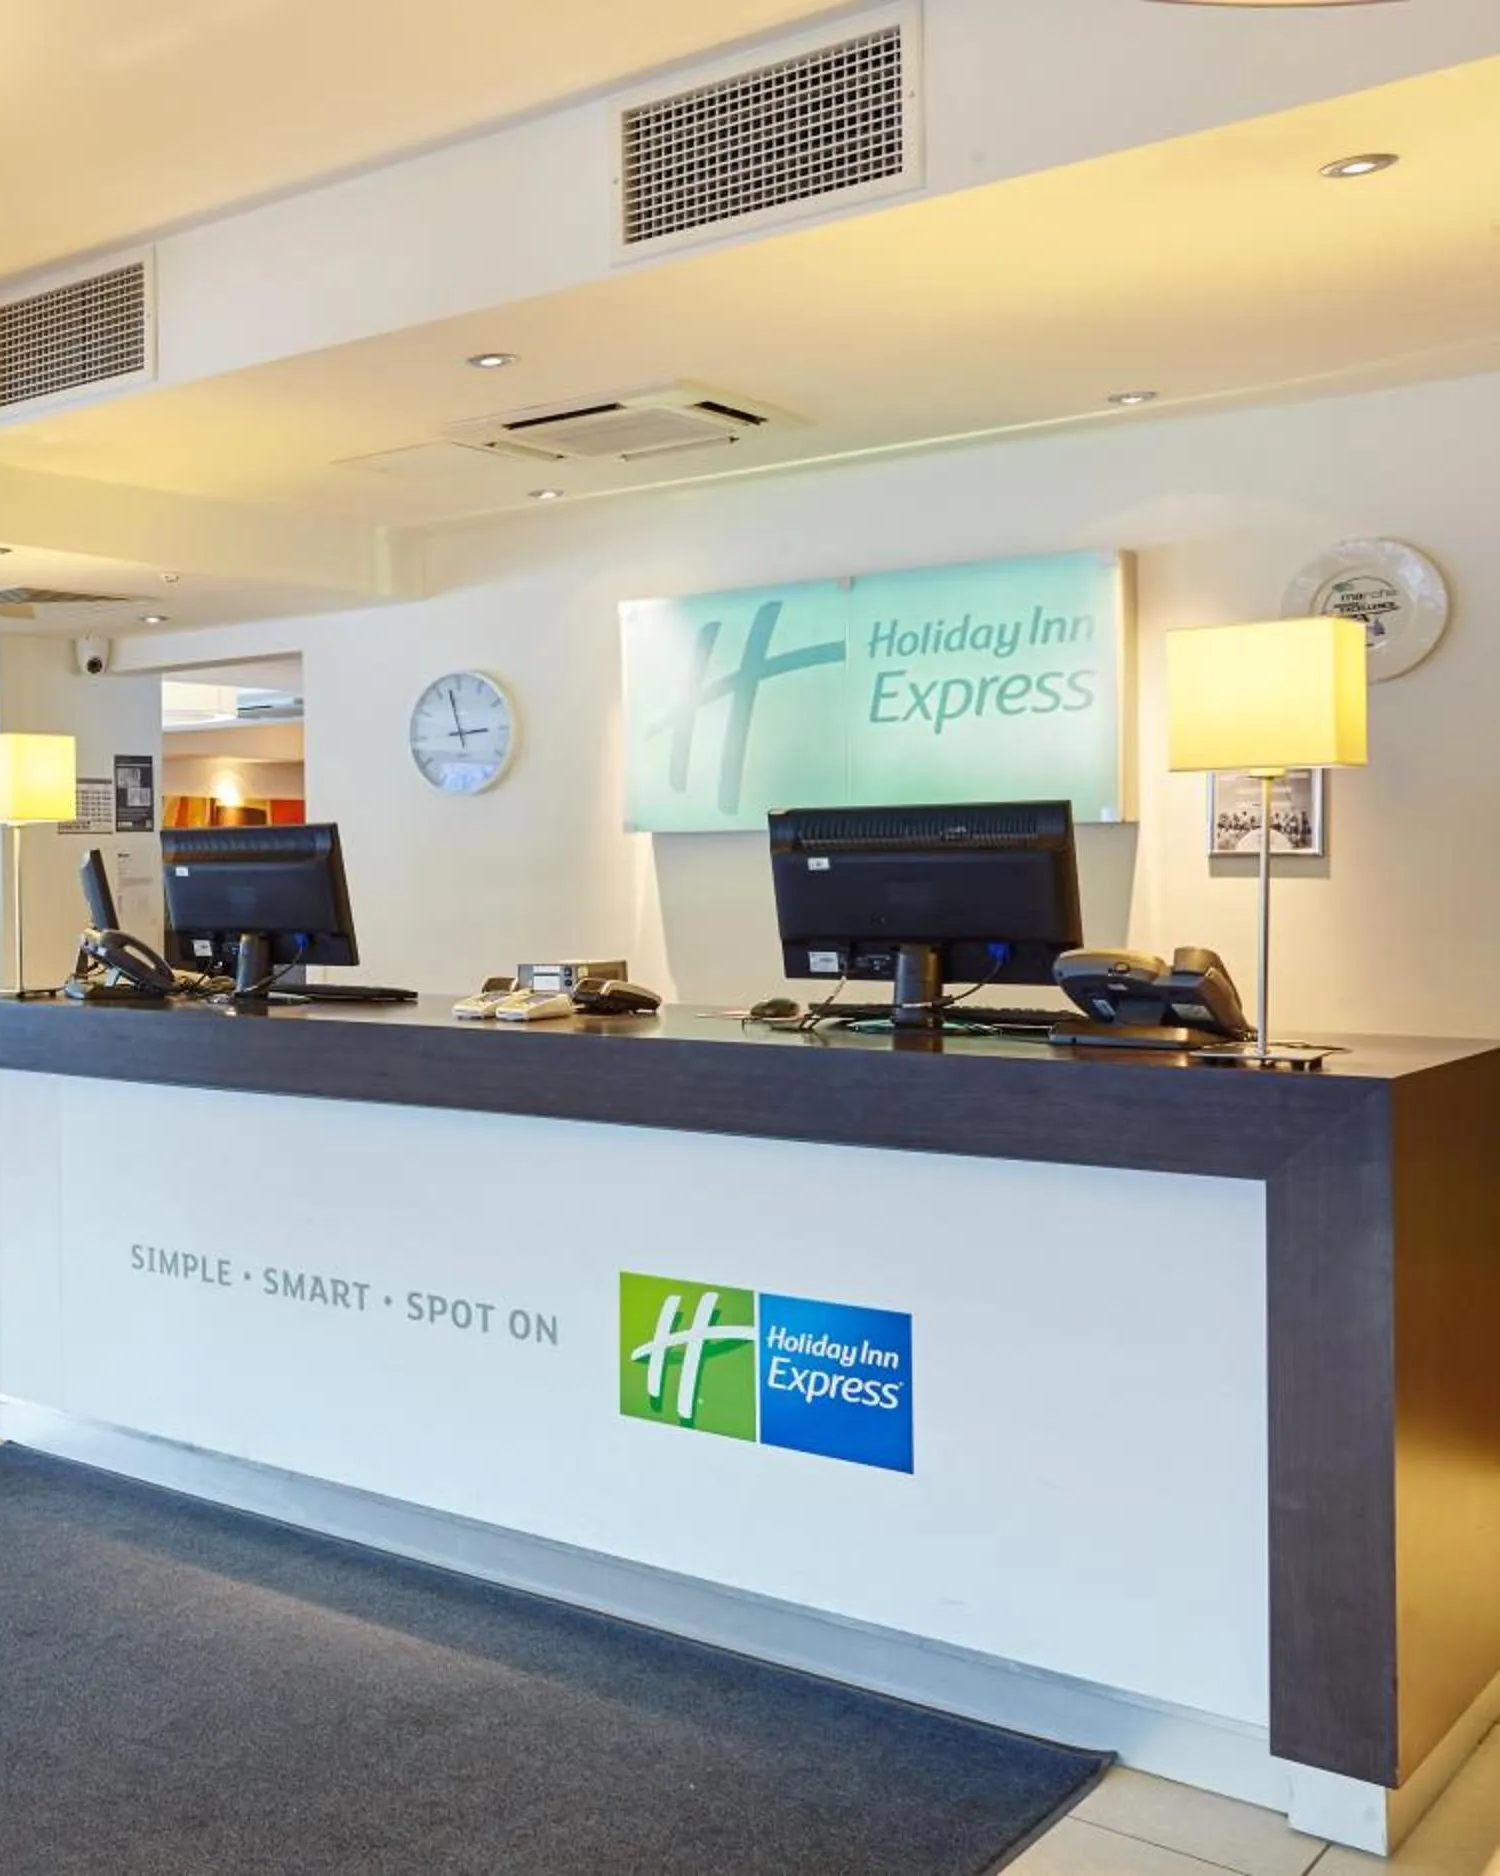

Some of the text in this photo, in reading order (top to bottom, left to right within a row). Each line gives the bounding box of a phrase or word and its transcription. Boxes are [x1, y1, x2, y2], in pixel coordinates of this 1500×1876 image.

[868, 605, 1097, 659] Holiday Inn
[868, 669, 1097, 735] Express
[131, 1243, 559, 1346] SIMPLE SMART SPOT ON
[767, 1325, 900, 1370] Holiday Inn
[767, 1355, 901, 1410] Express
